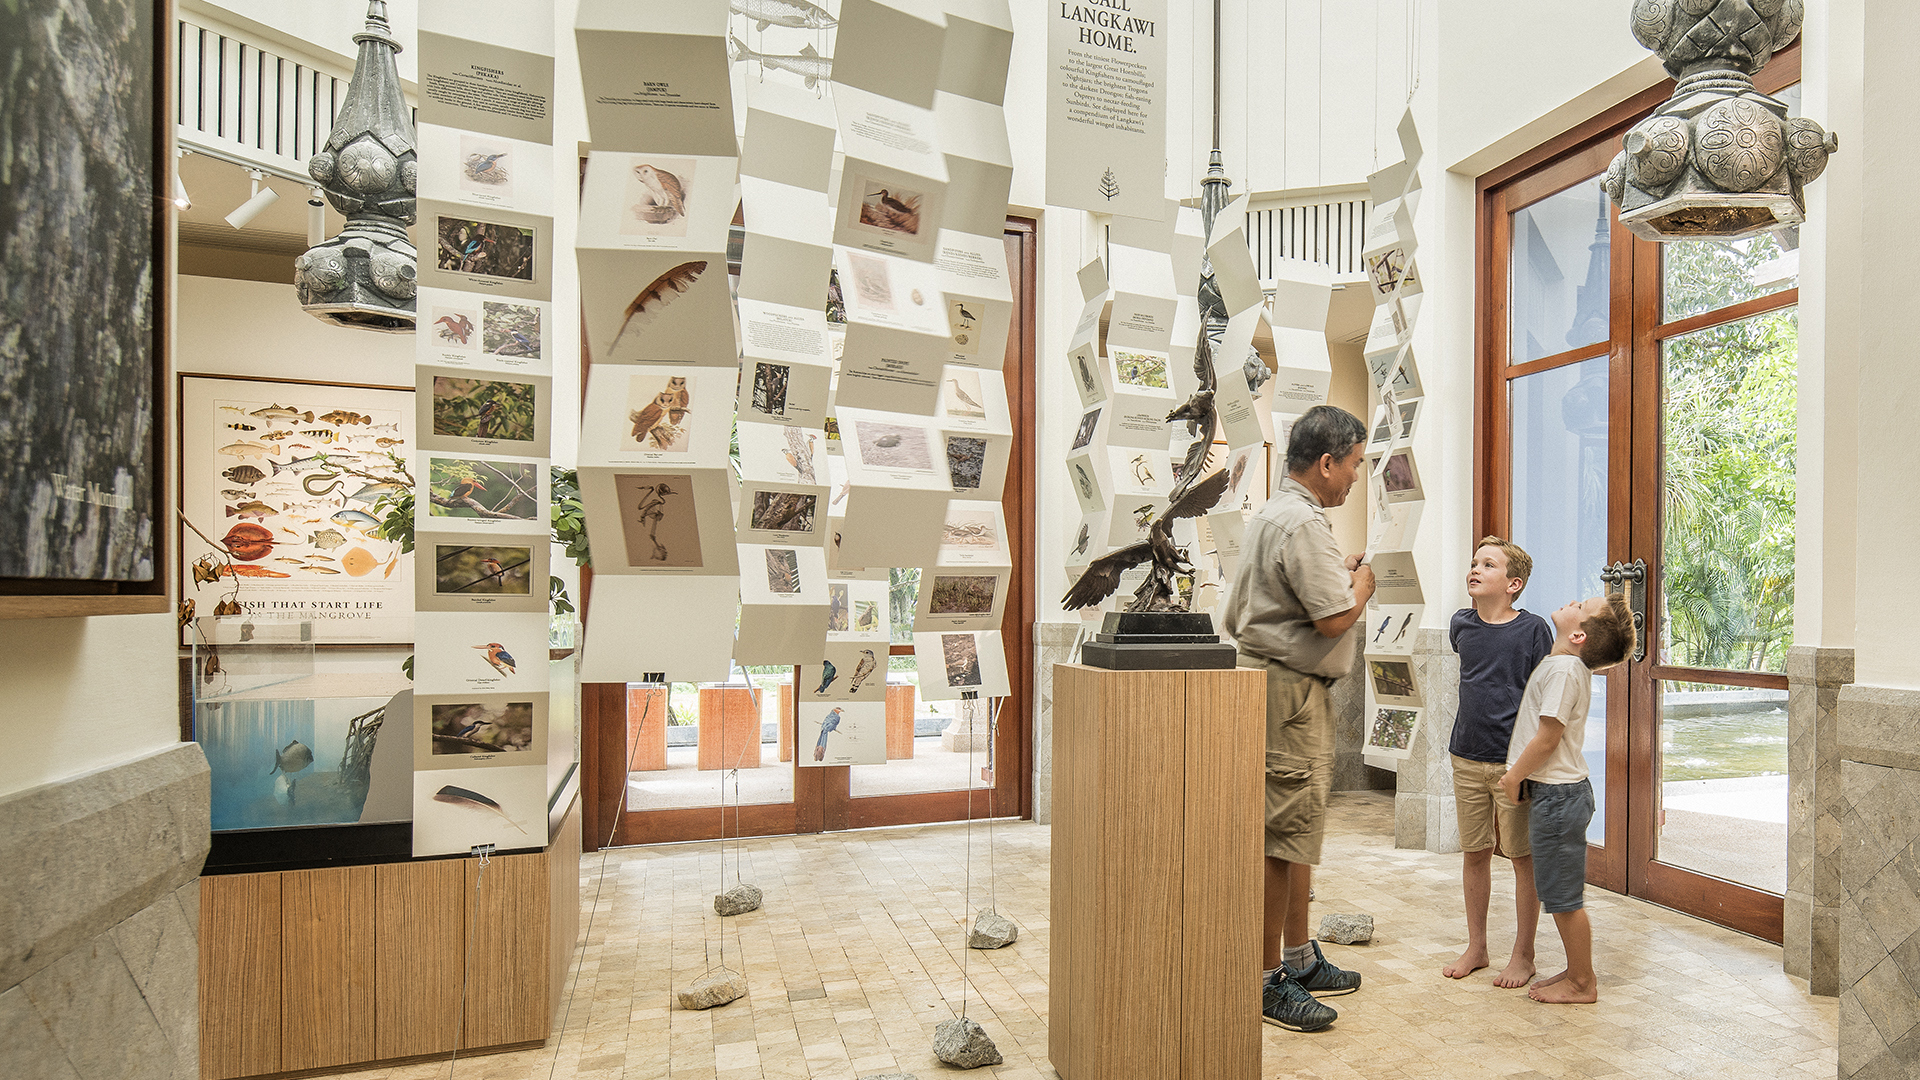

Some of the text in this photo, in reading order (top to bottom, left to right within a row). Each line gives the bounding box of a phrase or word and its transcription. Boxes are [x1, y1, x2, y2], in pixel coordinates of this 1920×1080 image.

[1060, 2, 1155, 38] LANGKAWI
[1079, 26, 1137, 54] HOME.
[1067, 48, 1147, 70] From the tiniest Flowerpeckers
[1076, 58, 1085, 66] the
[1086, 60, 1103, 69] largest
[1103, 64, 1119, 72] Great
[1060, 64, 1085, 74] colourful
[1085, 68, 1114, 80] Kingfishers
[1079, 84, 1099, 93] darkest
[1093, 78, 1102, 86] the
[1103, 80, 1127, 90] brightest
[1127, 84, 1148, 95] Trogons
[1073, 90, 1096, 101] Ospreys
[1073, 109, 1109, 119] compendium
[1092, 102, 1101, 110] See
[1102, 104, 1127, 114] displayed
[1127, 109, 1139, 117] here
[1066, 115, 1095, 125] wonderful
[1095, 120, 1115, 129] winged
[50, 472, 129, 509] Water Monitor
[271, 601, 307, 609] THAT
[311, 601, 351, 609] START
[355, 601, 383, 609] LIFE
[267, 611, 294, 619] THE
[300, 611, 372, 620] MANGROVE
